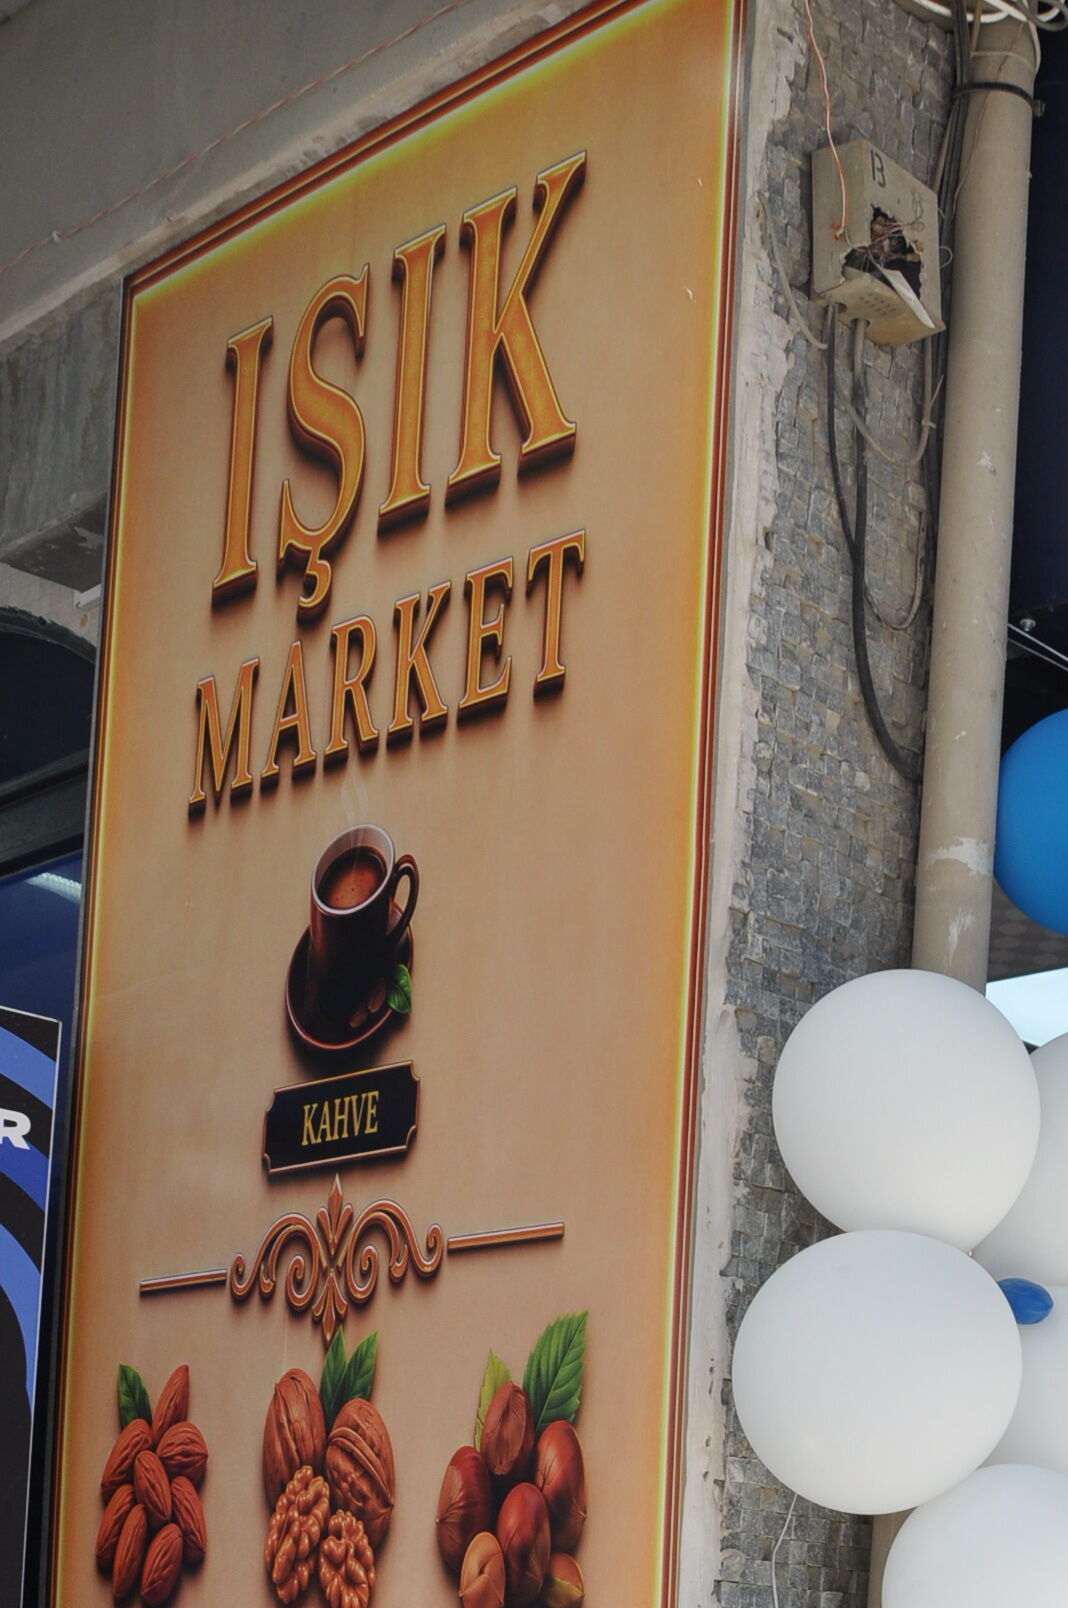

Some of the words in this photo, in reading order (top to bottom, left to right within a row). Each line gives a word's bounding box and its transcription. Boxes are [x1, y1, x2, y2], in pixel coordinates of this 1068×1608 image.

[212, 149, 588, 611] IŞIK
[188, 529, 587, 812] MARKET
[301, 1090, 379, 1146] KAHVE
